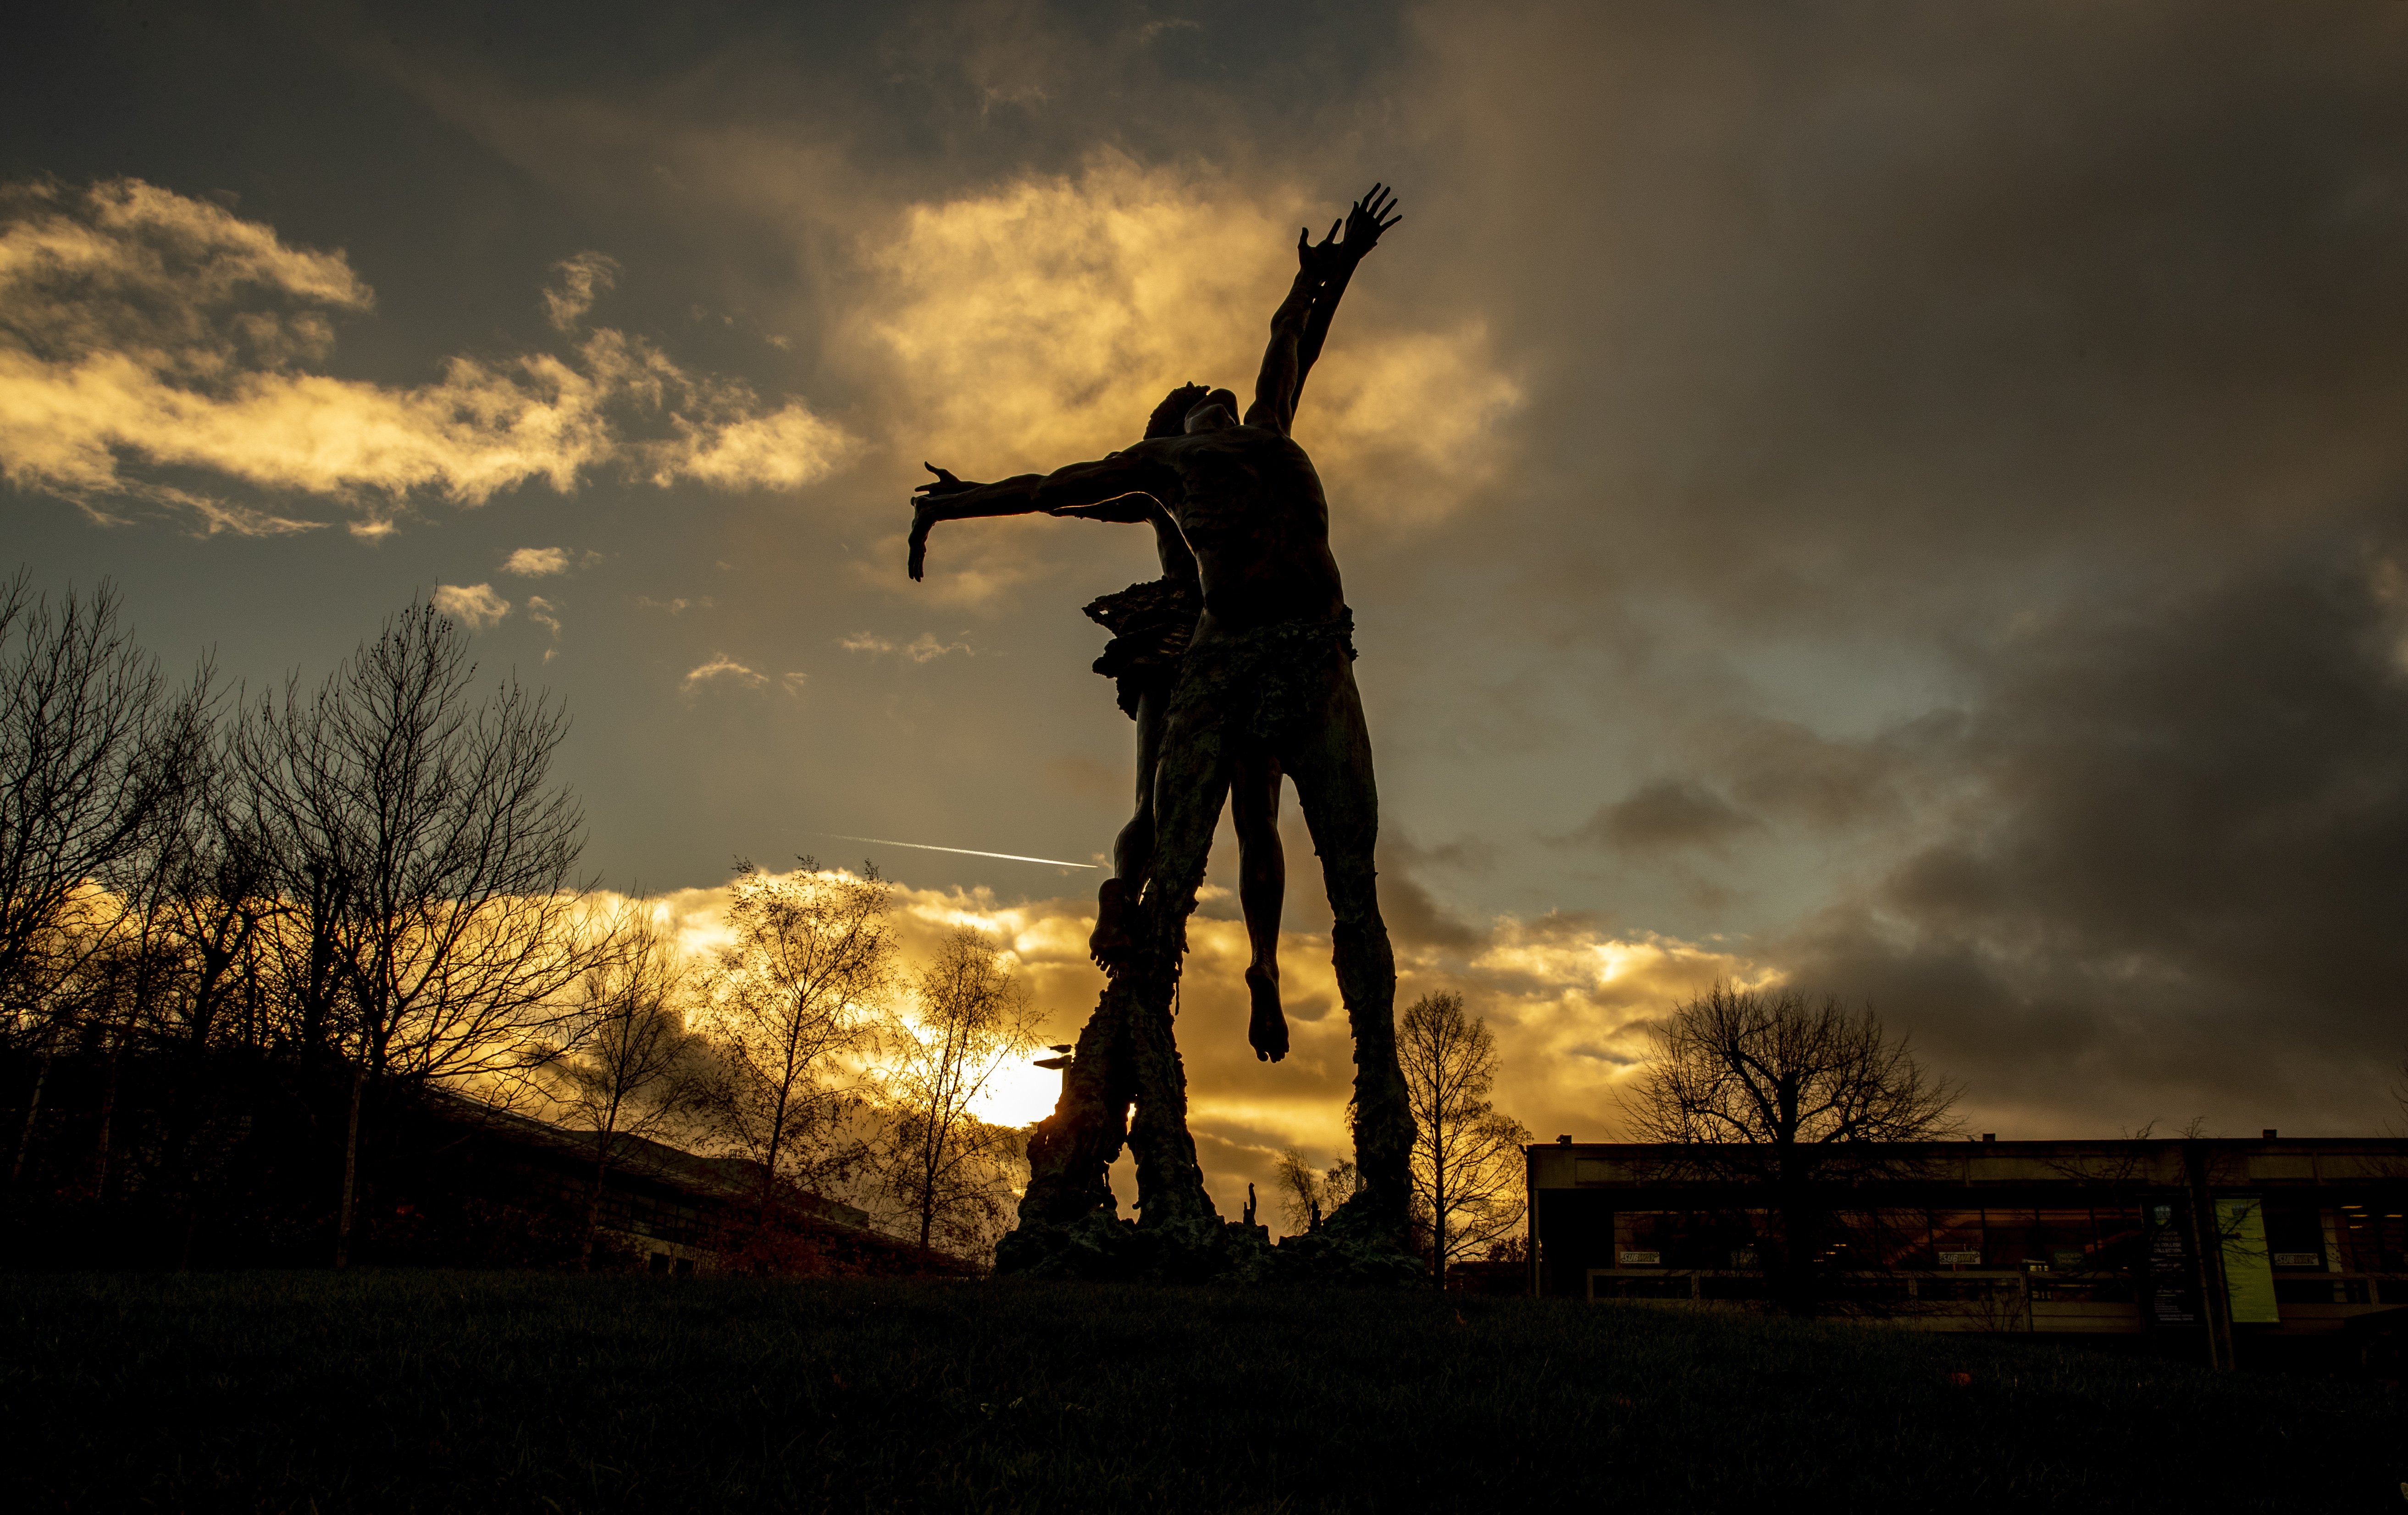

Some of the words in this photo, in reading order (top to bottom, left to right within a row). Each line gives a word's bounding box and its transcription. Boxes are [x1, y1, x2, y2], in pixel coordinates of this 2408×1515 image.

[1621, 1253, 1659, 1262] SUBWAY
[1940, 1253, 1979, 1263] SUBWAY
[2277, 1254, 2318, 1264] SUBWAY
